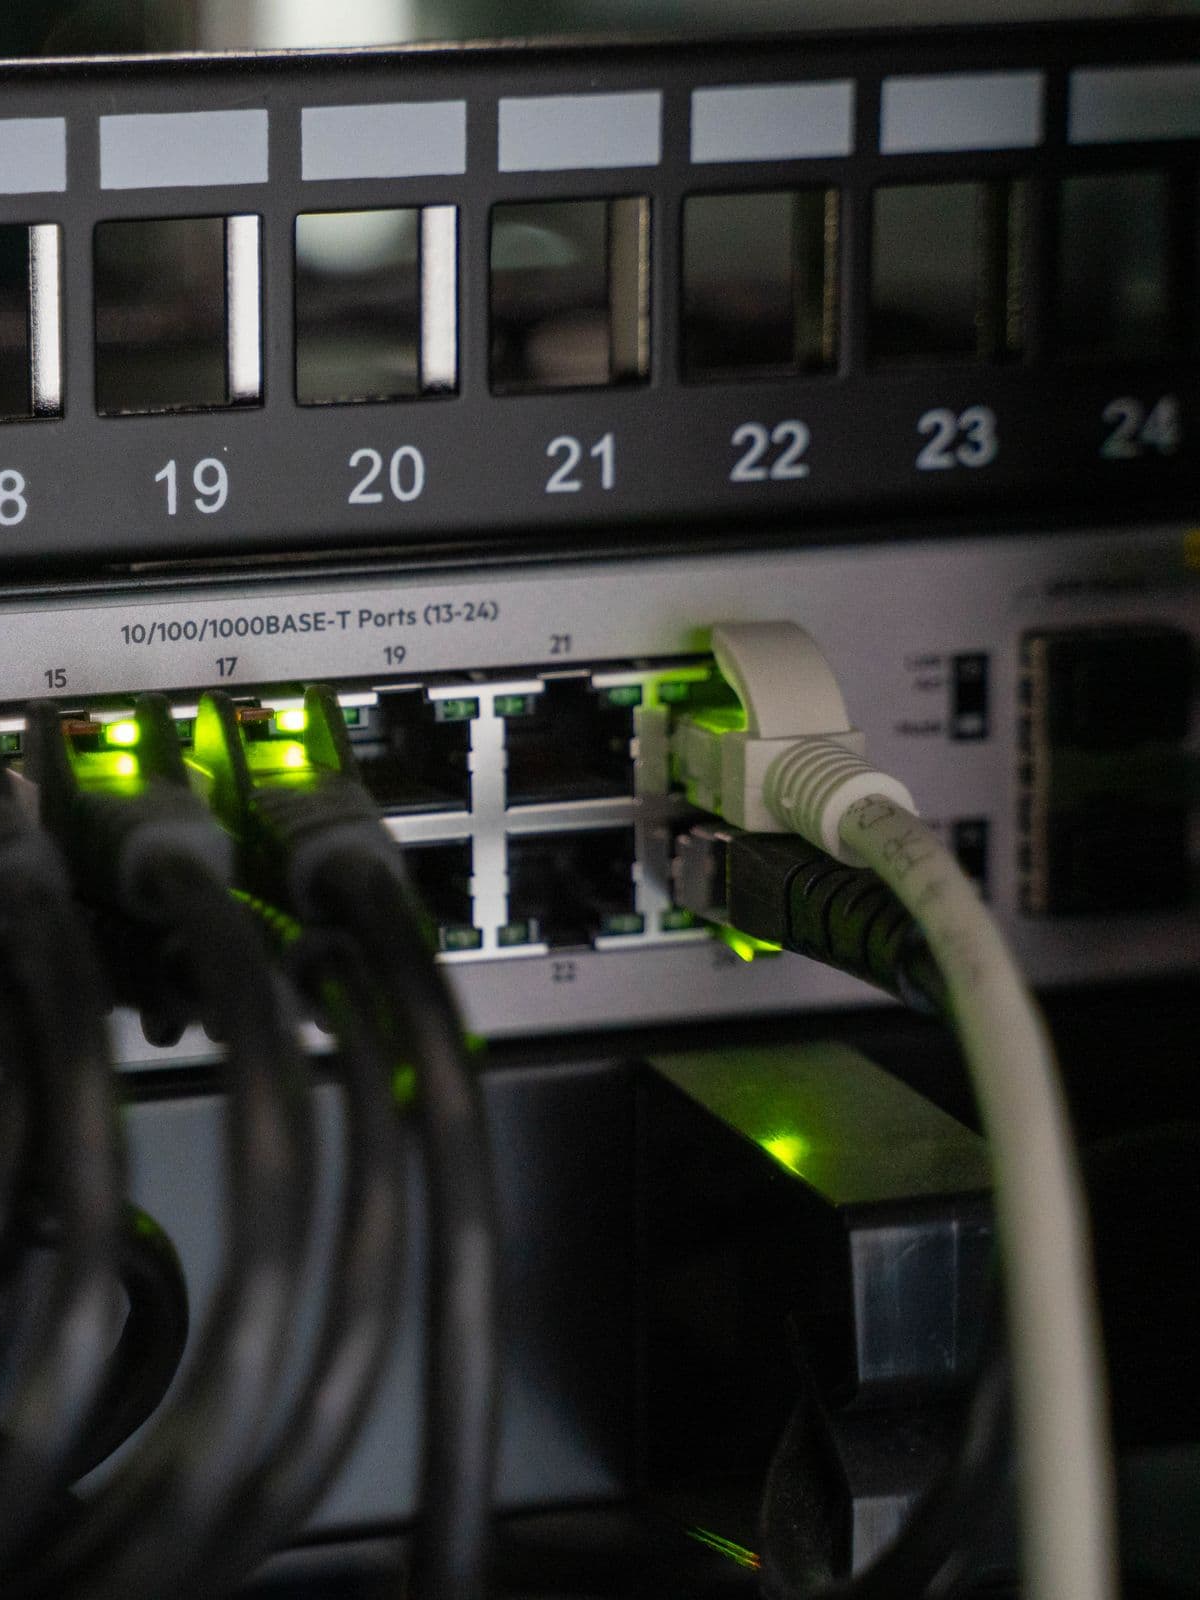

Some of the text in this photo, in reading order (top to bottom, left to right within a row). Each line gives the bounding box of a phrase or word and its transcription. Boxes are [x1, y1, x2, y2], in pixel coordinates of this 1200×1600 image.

[729, 419, 810, 482] 22
[915, 405, 999, 471] 23
[1100, 395, 1181, 460] 24
[153, 457, 230, 516] 19
[347, 445, 426, 505] 20
[545, 432, 616, 493] 21
[120, 600, 499, 645] 10/100/1000BASE-T Ports (13-24)
[550, 633, 572, 654] 21
[43, 668, 67, 689] 15
[215, 656, 238, 677] 17
[383, 645, 407, 665] 19
